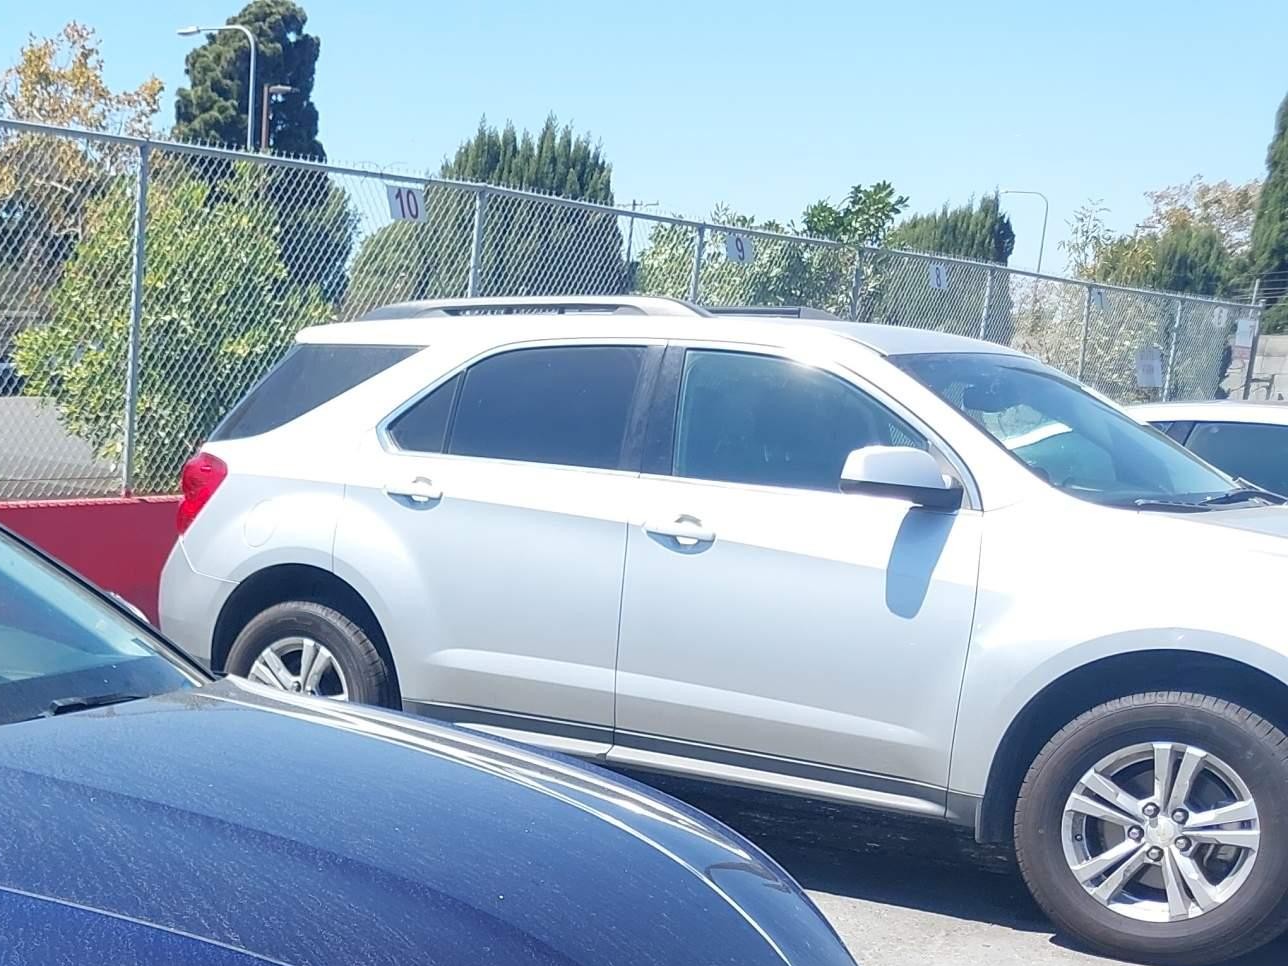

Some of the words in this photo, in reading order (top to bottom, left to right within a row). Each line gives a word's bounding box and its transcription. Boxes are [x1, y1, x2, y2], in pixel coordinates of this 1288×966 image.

[395, 188, 418, 219] 10
[735, 237, 745, 261] 9
[935, 266, 942, 287] 8
